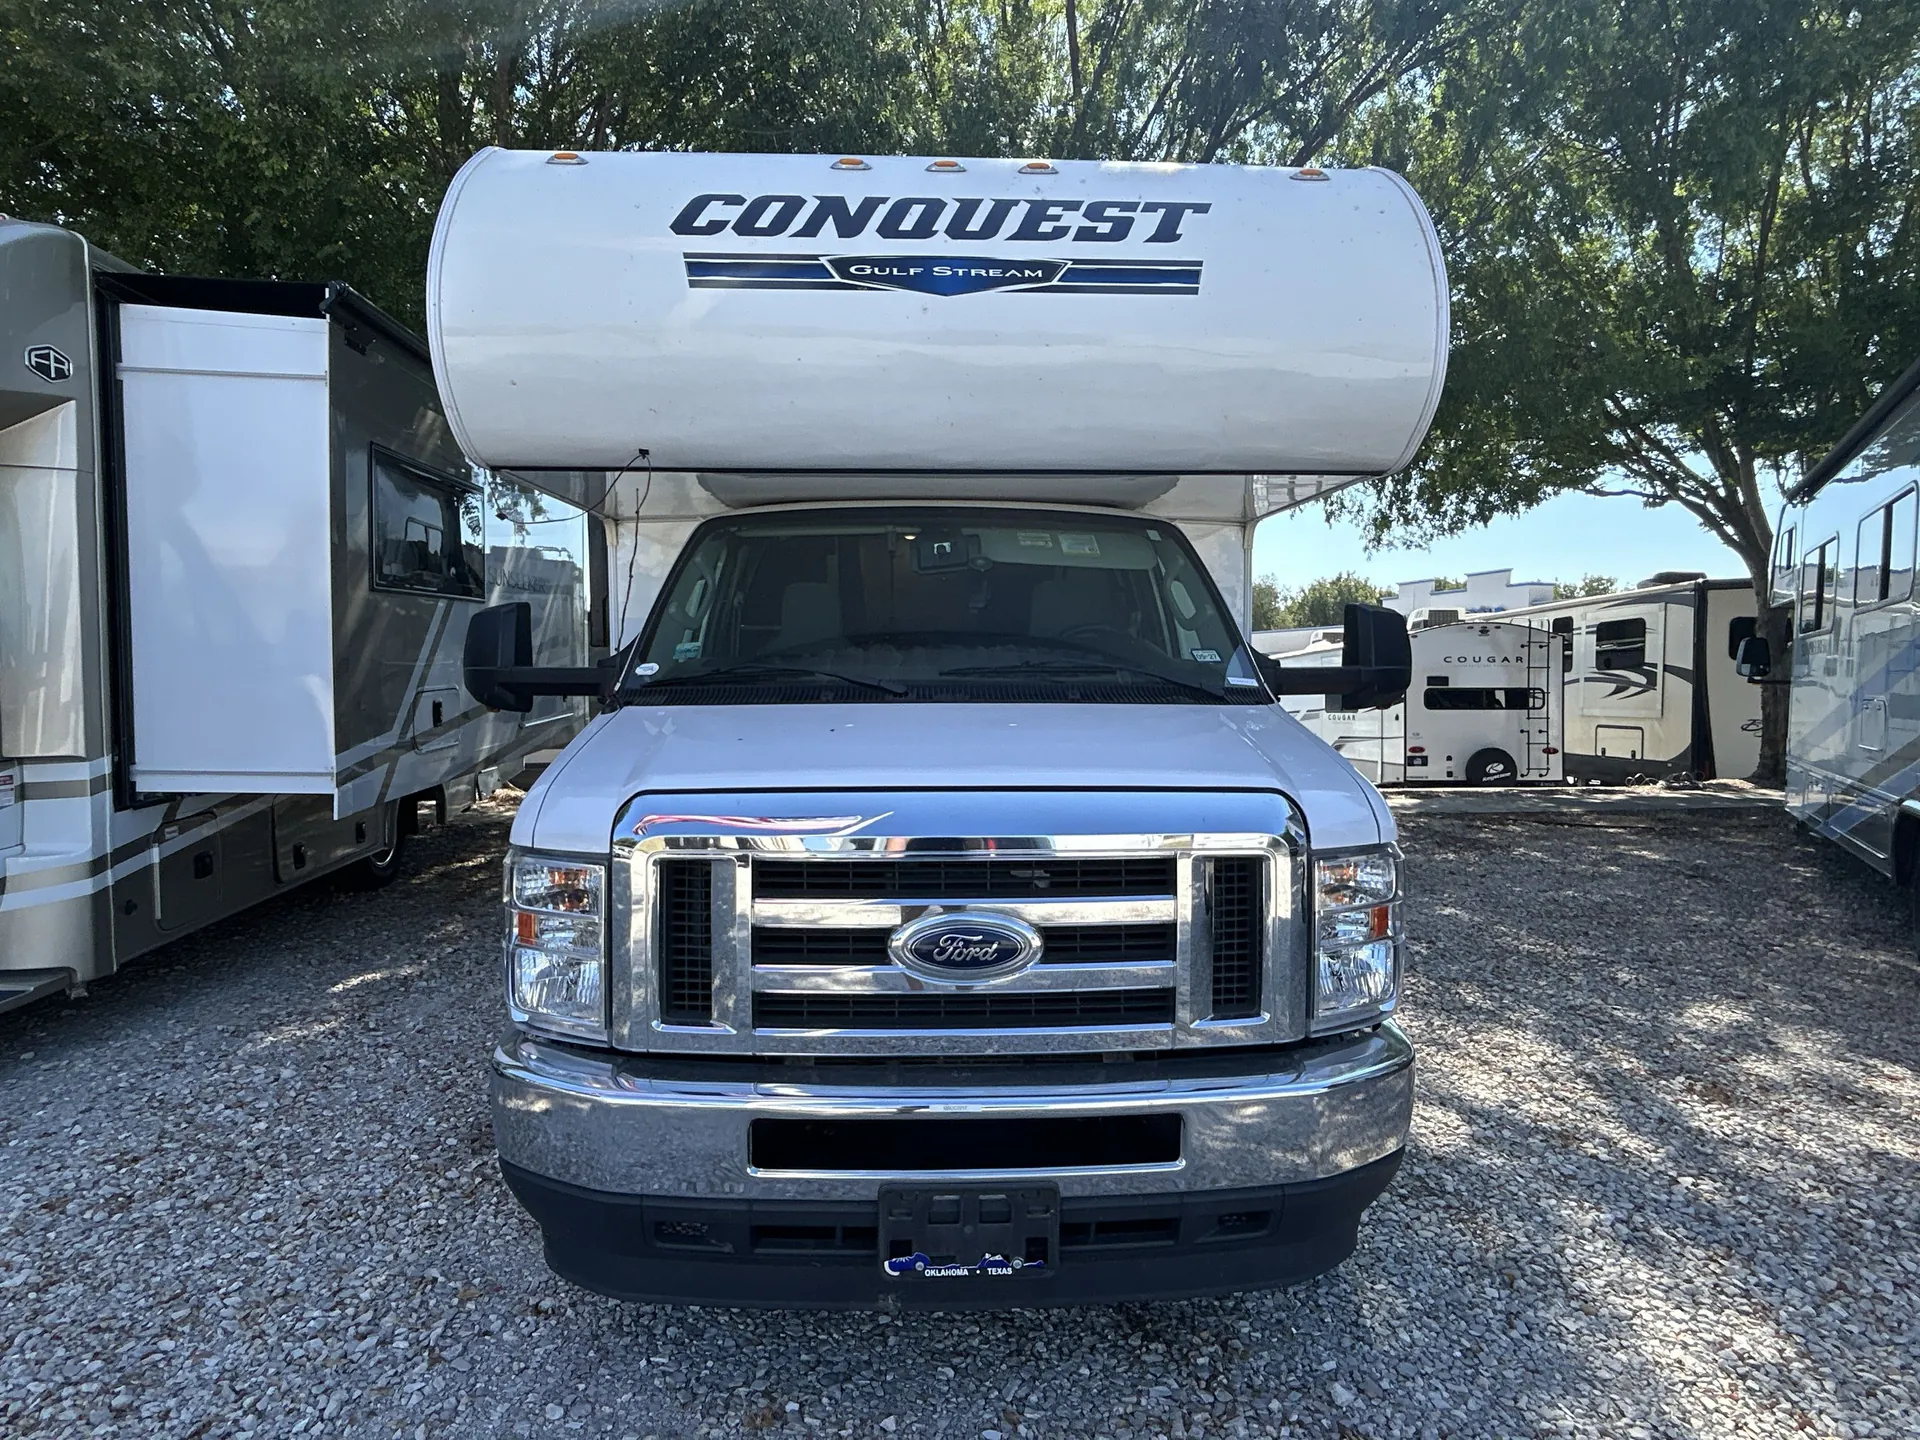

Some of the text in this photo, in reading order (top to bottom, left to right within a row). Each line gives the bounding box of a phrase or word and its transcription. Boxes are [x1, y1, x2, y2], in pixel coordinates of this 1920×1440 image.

[670, 193, 1212, 243] CONQUEST
[1443, 655, 1524, 664] COUGAR
[932, 933, 1000, 962] Ford
[924, 1267, 1013, 1277] OKLAHOMA TEXAS
